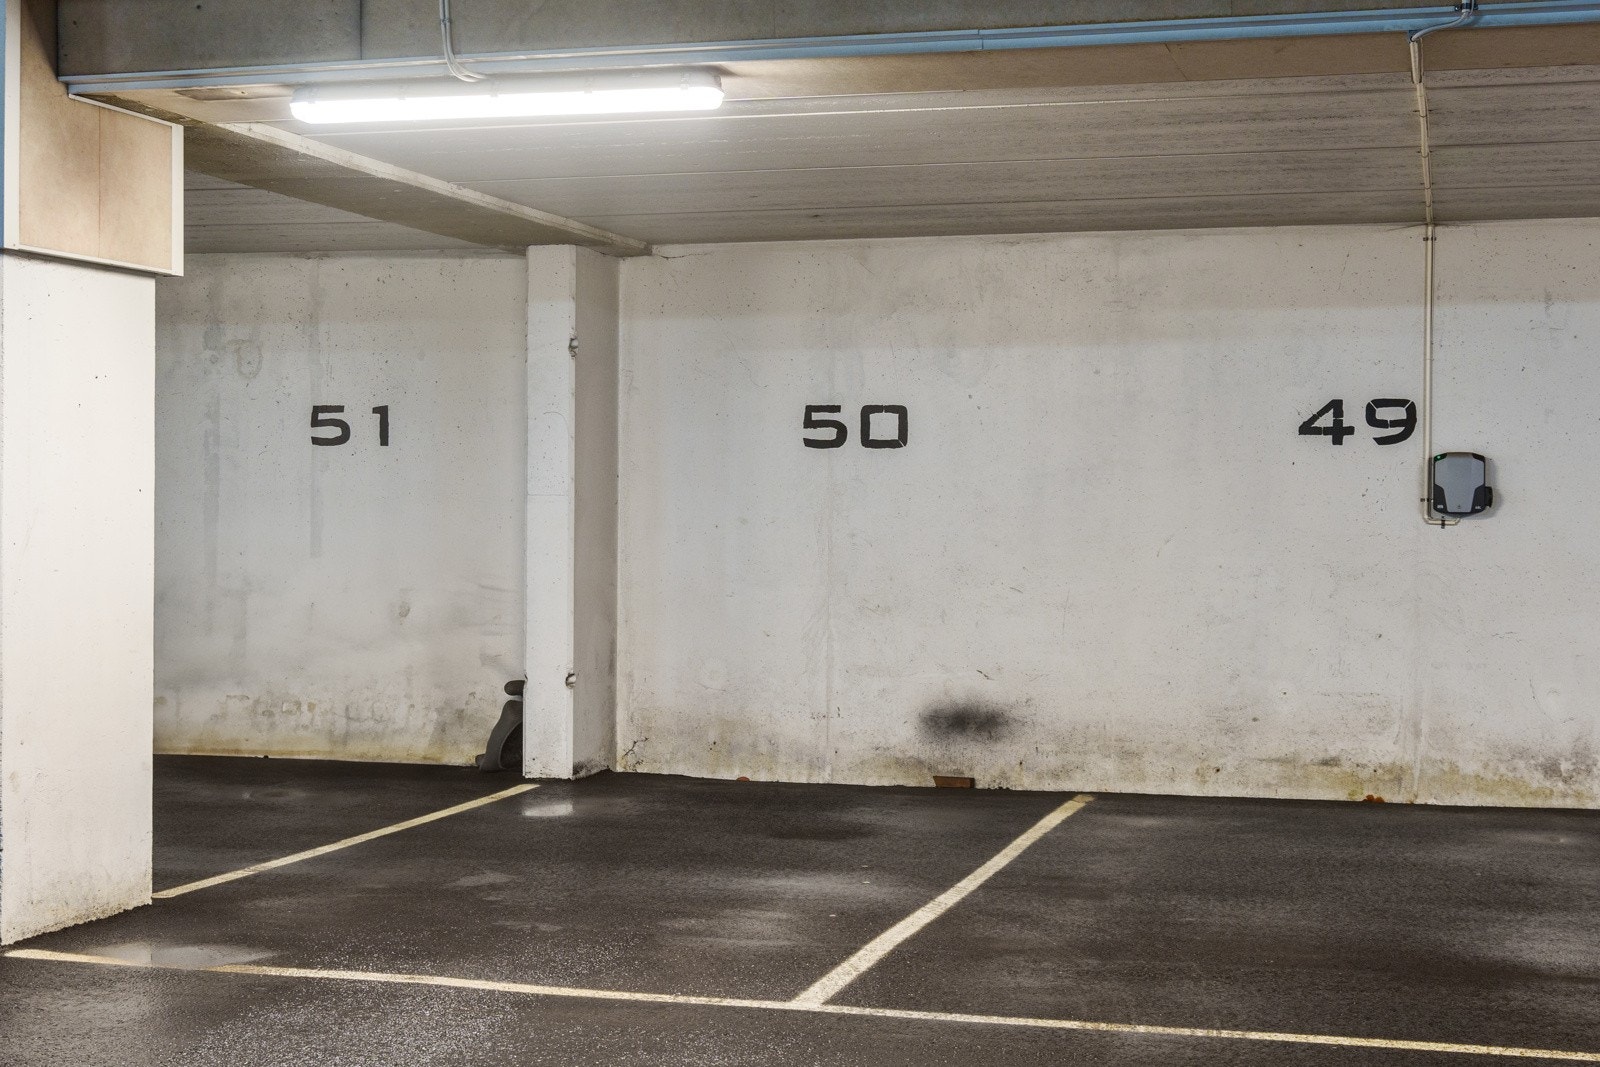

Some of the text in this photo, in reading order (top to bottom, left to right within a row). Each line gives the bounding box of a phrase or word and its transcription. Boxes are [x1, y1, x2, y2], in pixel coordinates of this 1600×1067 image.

[310, 404, 390, 447] 51
[803, 405, 909, 450] 50
[1298, 398, 1418, 446] 49
